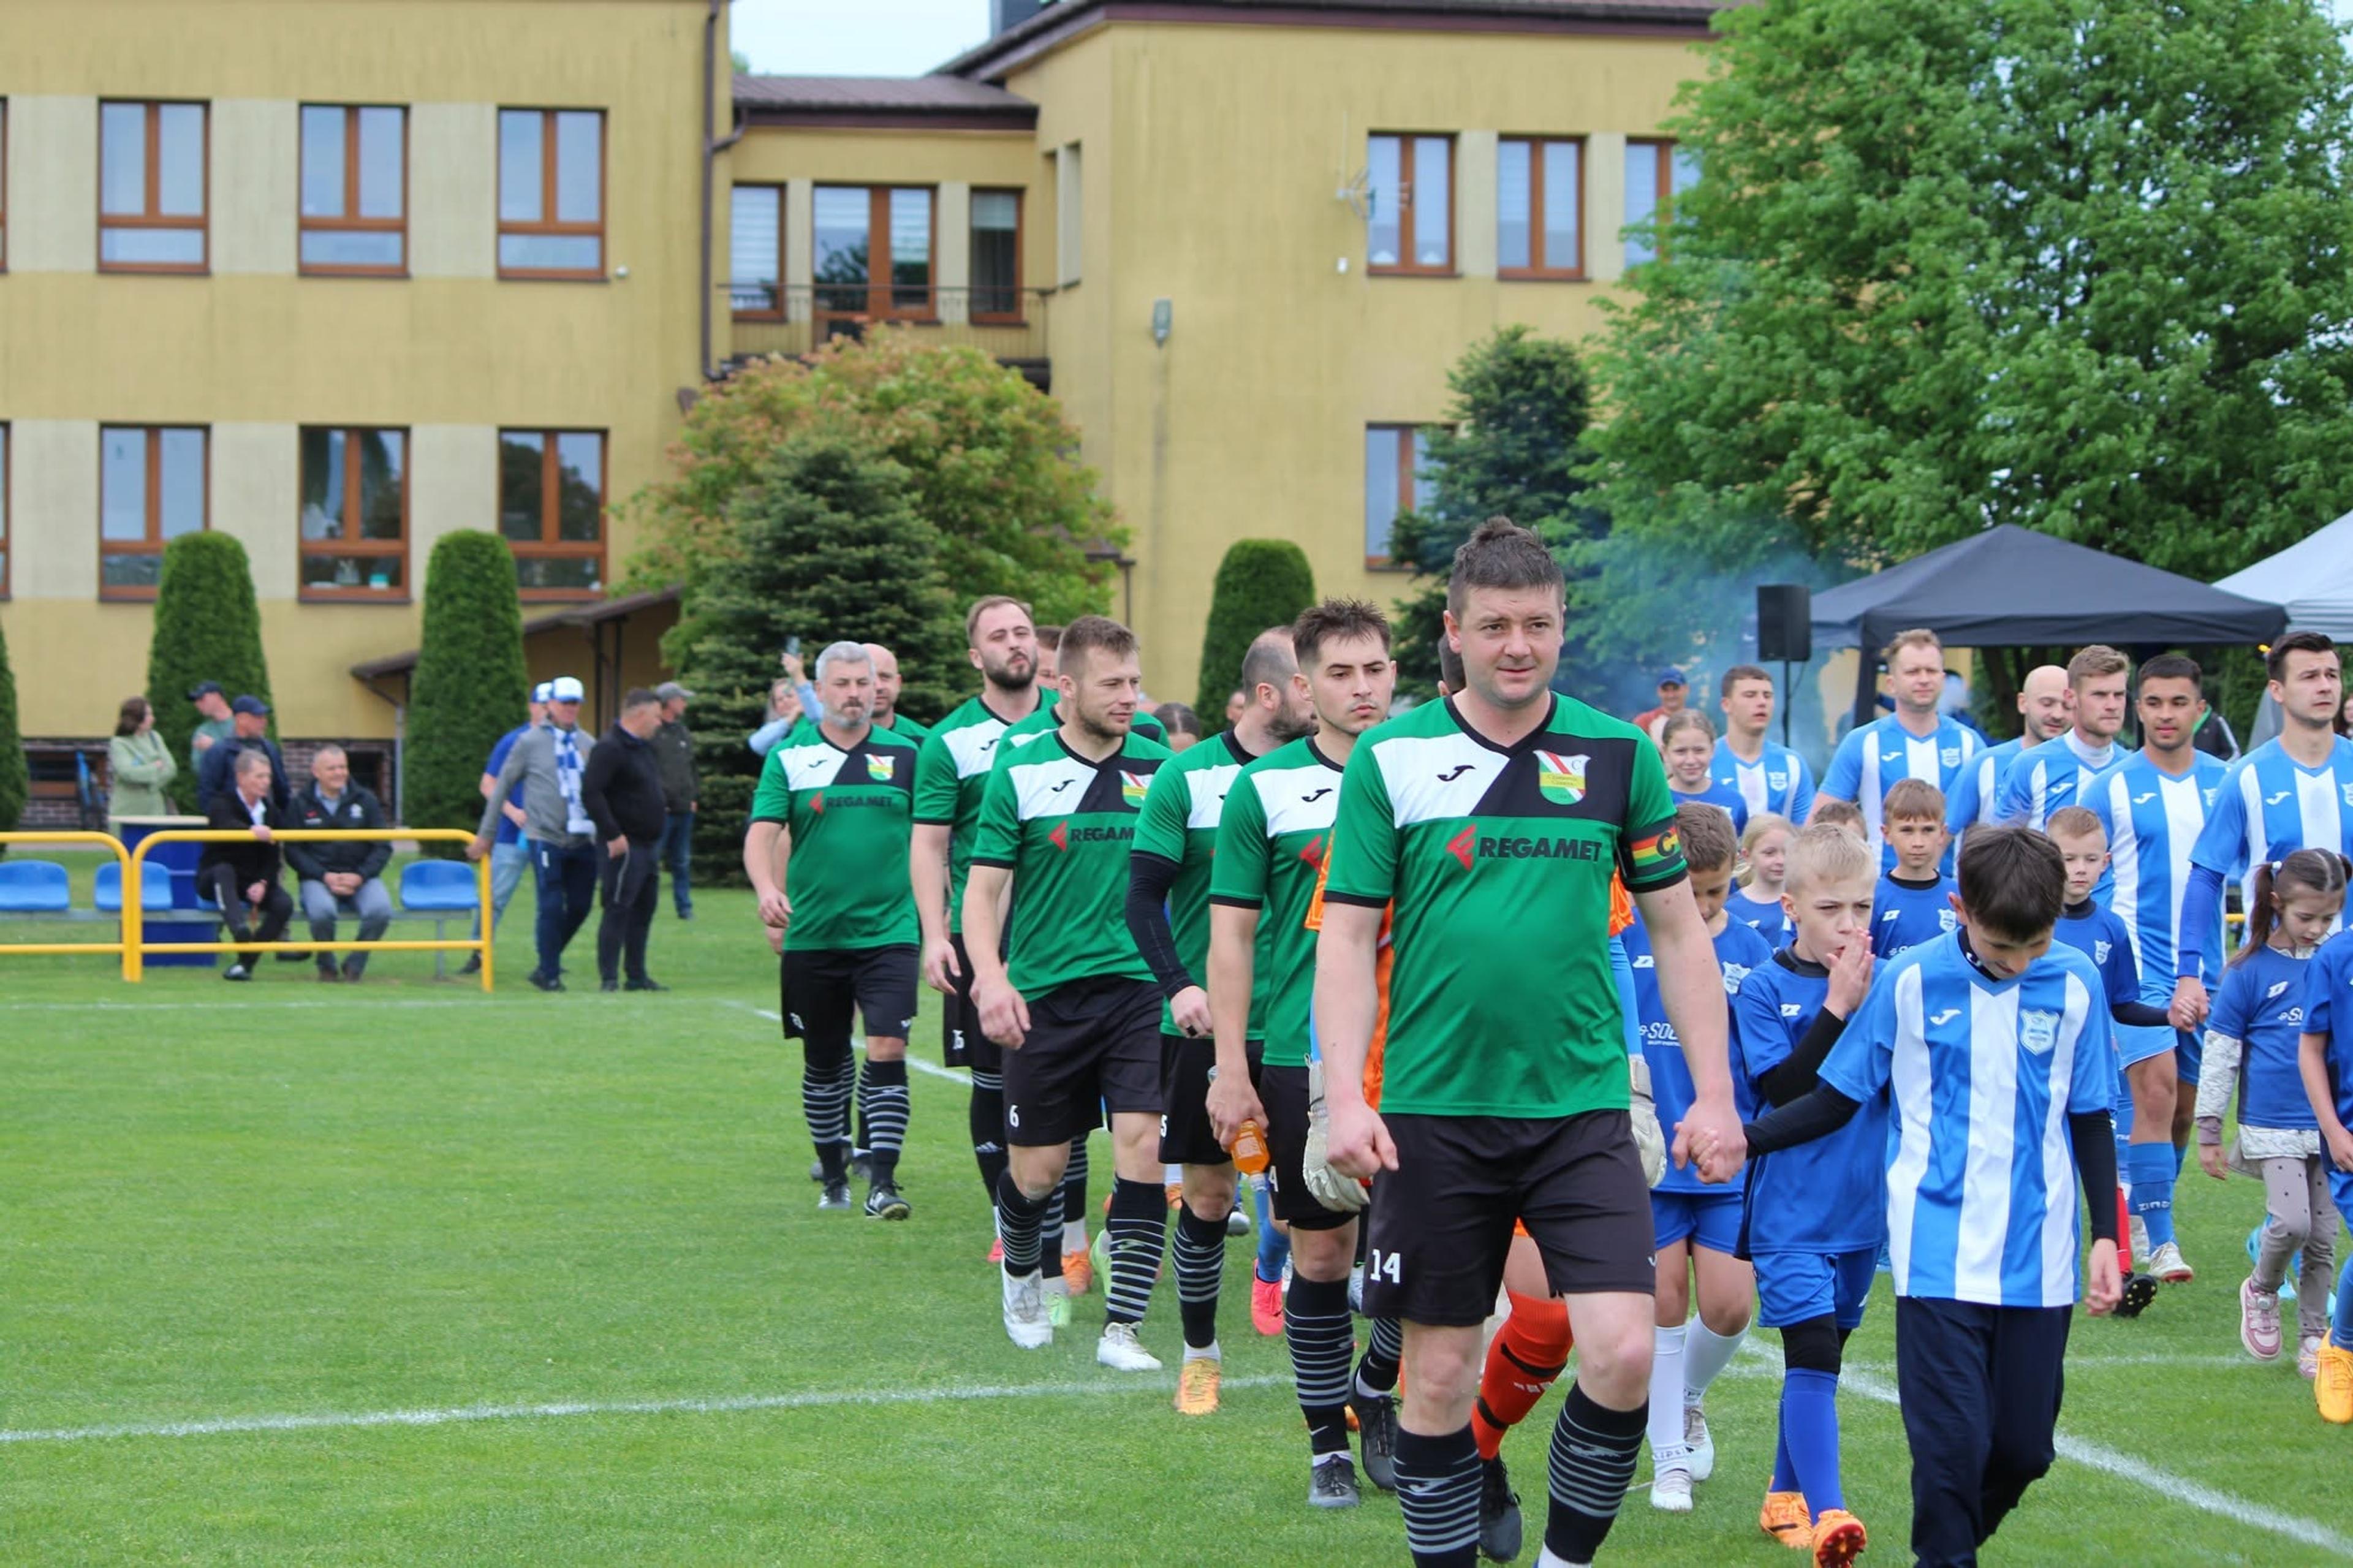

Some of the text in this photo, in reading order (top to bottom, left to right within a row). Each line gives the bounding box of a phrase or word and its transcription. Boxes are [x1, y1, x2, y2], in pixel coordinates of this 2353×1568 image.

[1070, 827, 1135, 841] REGAM
[1657, 831, 1675, 857] C
[1479, 837, 1602, 862] REGAMET
[1009, 1104, 1020, 1128] 6
[1370, 1249, 1400, 1284] 14
